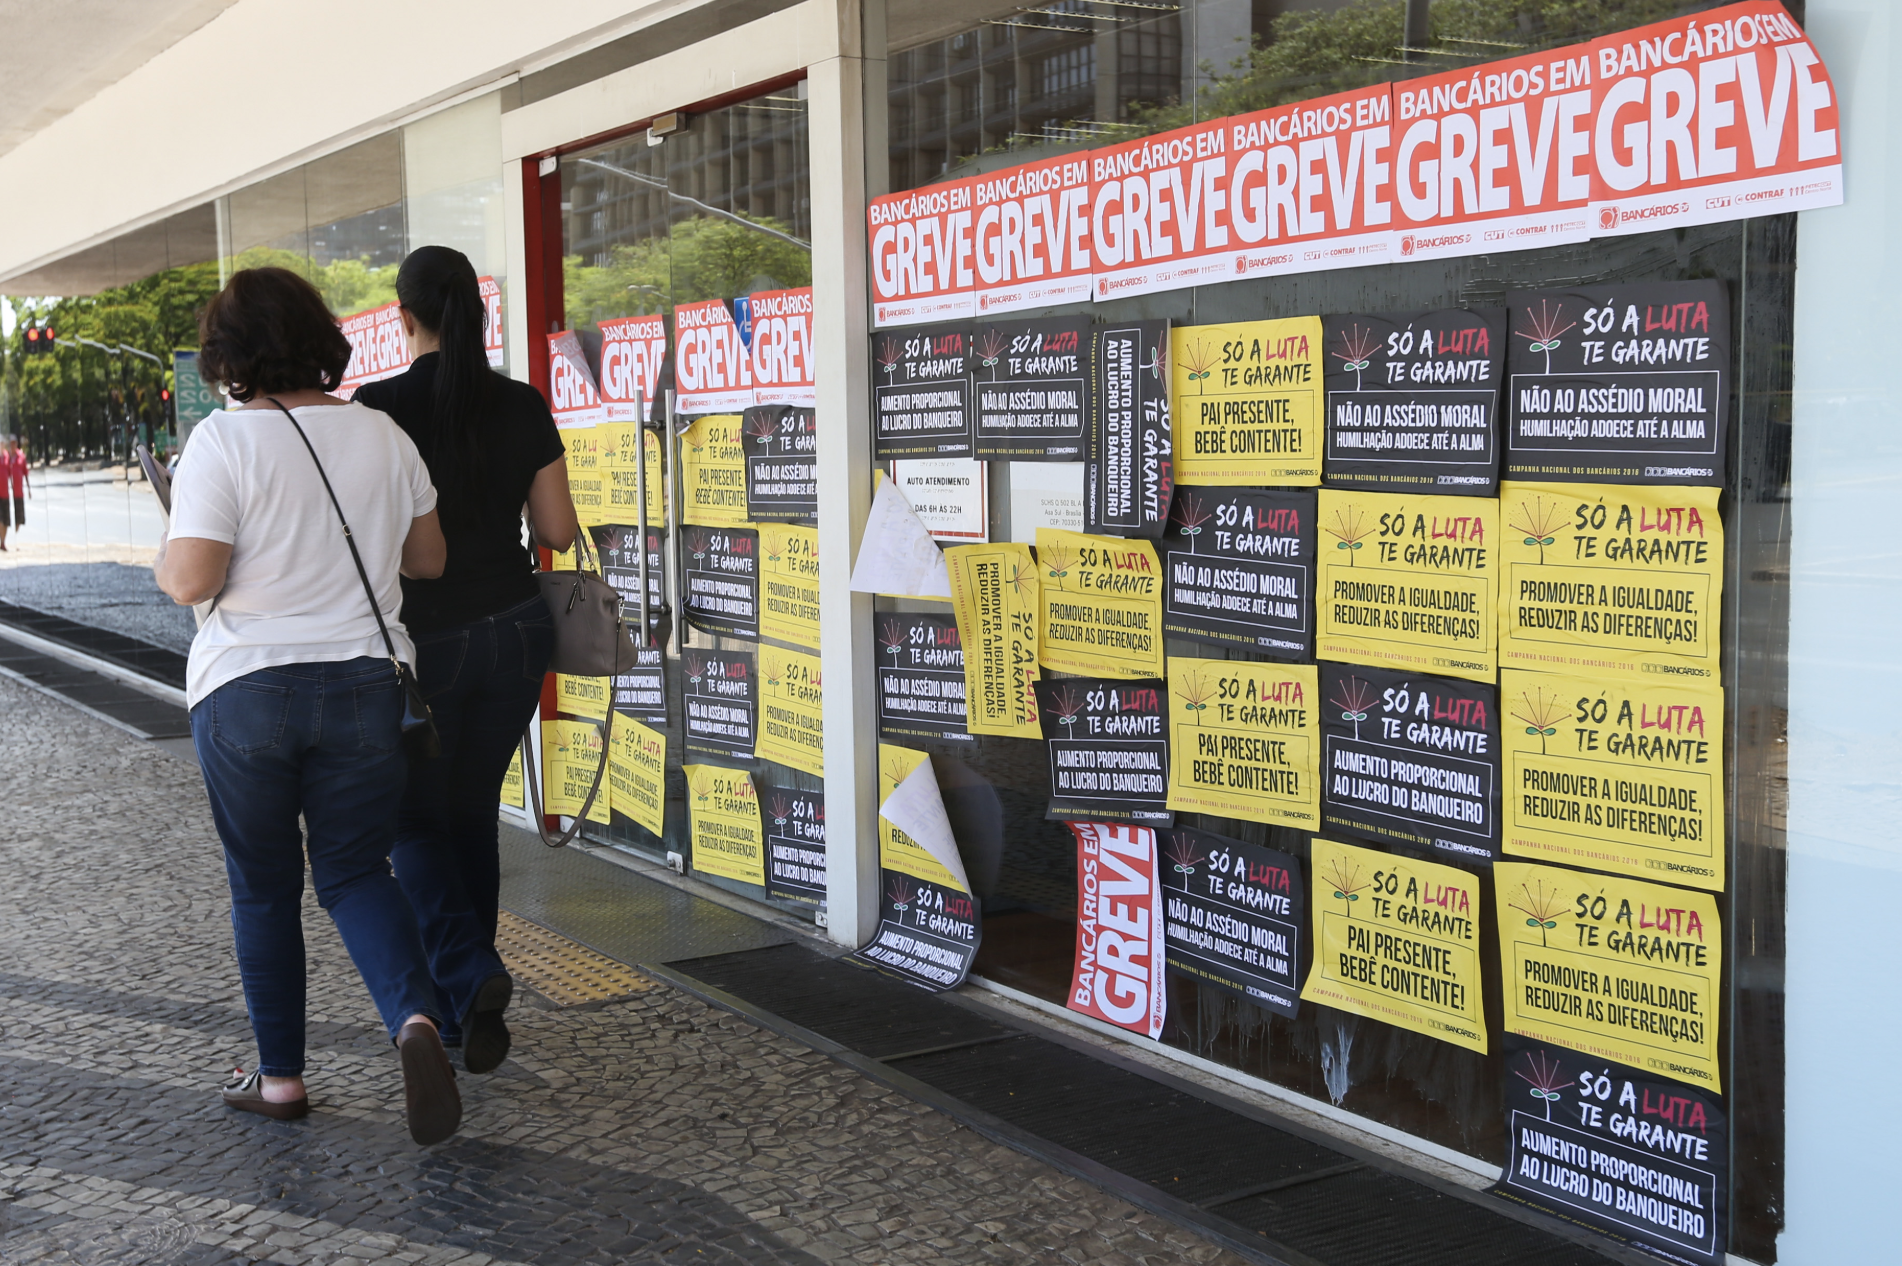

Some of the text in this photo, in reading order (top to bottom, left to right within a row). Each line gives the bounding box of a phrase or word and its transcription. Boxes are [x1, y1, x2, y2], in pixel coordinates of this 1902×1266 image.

[1598, 12, 1802, 80] BANCÁRIOS EM
[1400, 56, 1591, 120] BANCÁRIOS EM
[1233, 95, 1389, 150] BANCÁRIOS EM
[1595, 42, 1836, 191] GREVE
[1094, 128, 1225, 182] BANCÁRIOS EM
[1395, 89, 1589, 222] GREVE
[976, 160, 1087, 205] BANCÁRIOS EM
[1231, 125, 1391, 243] GREVE
[1745, 189, 1784, 201] CONTRAF
[870, 186, 971, 226] BANCÁRIOS EM
[1093, 157, 1228, 266] GREVE
[1621, 204, 1679, 221] BANCÁRIOS
[976, 186, 1090, 283] GREVE
[1417, 234, 1464, 248] BANCÁRIOS
[1516, 225, 1547, 235] CONTRAF
[872, 211, 974, 298] GREVE
[1249, 254, 1287, 267] BANCÁRIOS
[752, 293, 812, 317] BANCÁRIOS
[1583, 298, 1709, 336] SÓ A LUTA
[602, 321, 652, 341] BANCÁRIOS
[1223, 333, 1309, 364] SÓ A LUTA
[1581, 337, 1709, 365] TE GARANTE
[1222, 364, 1311, 388] TE GARANTE
[1201, 399, 1294, 426] PAI PRESENTE,
[1520, 384, 1706, 413] NÃO AO ASSÉDIO MORAL
[1107, 340, 1119, 517] AO LUCRO DO BANQUEIRO
[1120, 339, 1132, 516] AUMENTO PROPORCIONAL
[1195, 426, 1301, 454] BEBÊ CONTENTE!
[1520, 417, 1705, 440] HUMILHAÇÃO ADOECE ATÉ A ALMA
[700, 469, 743, 487] PAI PRESENTE,
[1144, 398, 1158, 522] TE GARANTE
[1509, 465, 1540, 473] CAMPANHA
[1541, 466, 1570, 474] NACIONAL
[1573, 466, 1584, 474] DOS
[1587, 466, 1621, 475] BANCÁRIOS
[1666, 467, 1706, 476] BANCÁRIOS
[907, 477, 970, 486] AUTO ATENDIMENTO
[950, 506, 961, 514] 22H
[1576, 496, 1704, 538] SÓ A LUTA
[711, 531, 752, 556] SÓ A LUTA
[1573, 536, 1708, 566] TE GARANTE
[711, 555, 753, 573] TE GARANTE
[1520, 580, 1697, 616] PROMOVER A IGUALDADE,
[1519, 607, 1697, 644] REDUZIR AS DIFERENÇAS!
[1507, 651, 1634, 671] CAMPANHA NACIONAL DOS BANCÁRIOS 2016
[1663, 665, 1704, 677] BANCÁRIOS
[1576, 690, 1705, 738] SÓ A LUTA
[1575, 728, 1708, 765] TE GARANTE
[1523, 769, 1702, 815] PROMOVER A IGUALDADE,
[1524, 795, 1702, 842] REDUZIR AS DIFERENÇAS!
[917, 885, 973, 921] SÓ A LUTA
[1373, 867, 1470, 918] SÓ A LUTA
[916, 909, 974, 939] TE GARANTE
[1073, 823, 1101, 1007] BANCÁRIOS EM
[1093, 823, 1150, 1024] GREVE
[1372, 897, 1472, 939] TE GARANTE
[878, 931, 914, 954] AUMENTO
[911, 940, 963, 970] PROPORCIONAL
[1348, 925, 1456, 980] PAI PRESENTE,
[1340, 953, 1465, 1011] BEBÊ CONTENTE!
[1579, 1069, 1707, 1135] SÓ A LUTA
[1578, 1101, 1709, 1161] TE GARANTE
[1522, 1128, 1704, 1209] AUMENTO PROPORCIONAL
[1520, 1154, 1705, 1239] AO LUCRO DO BANQUEIRO
